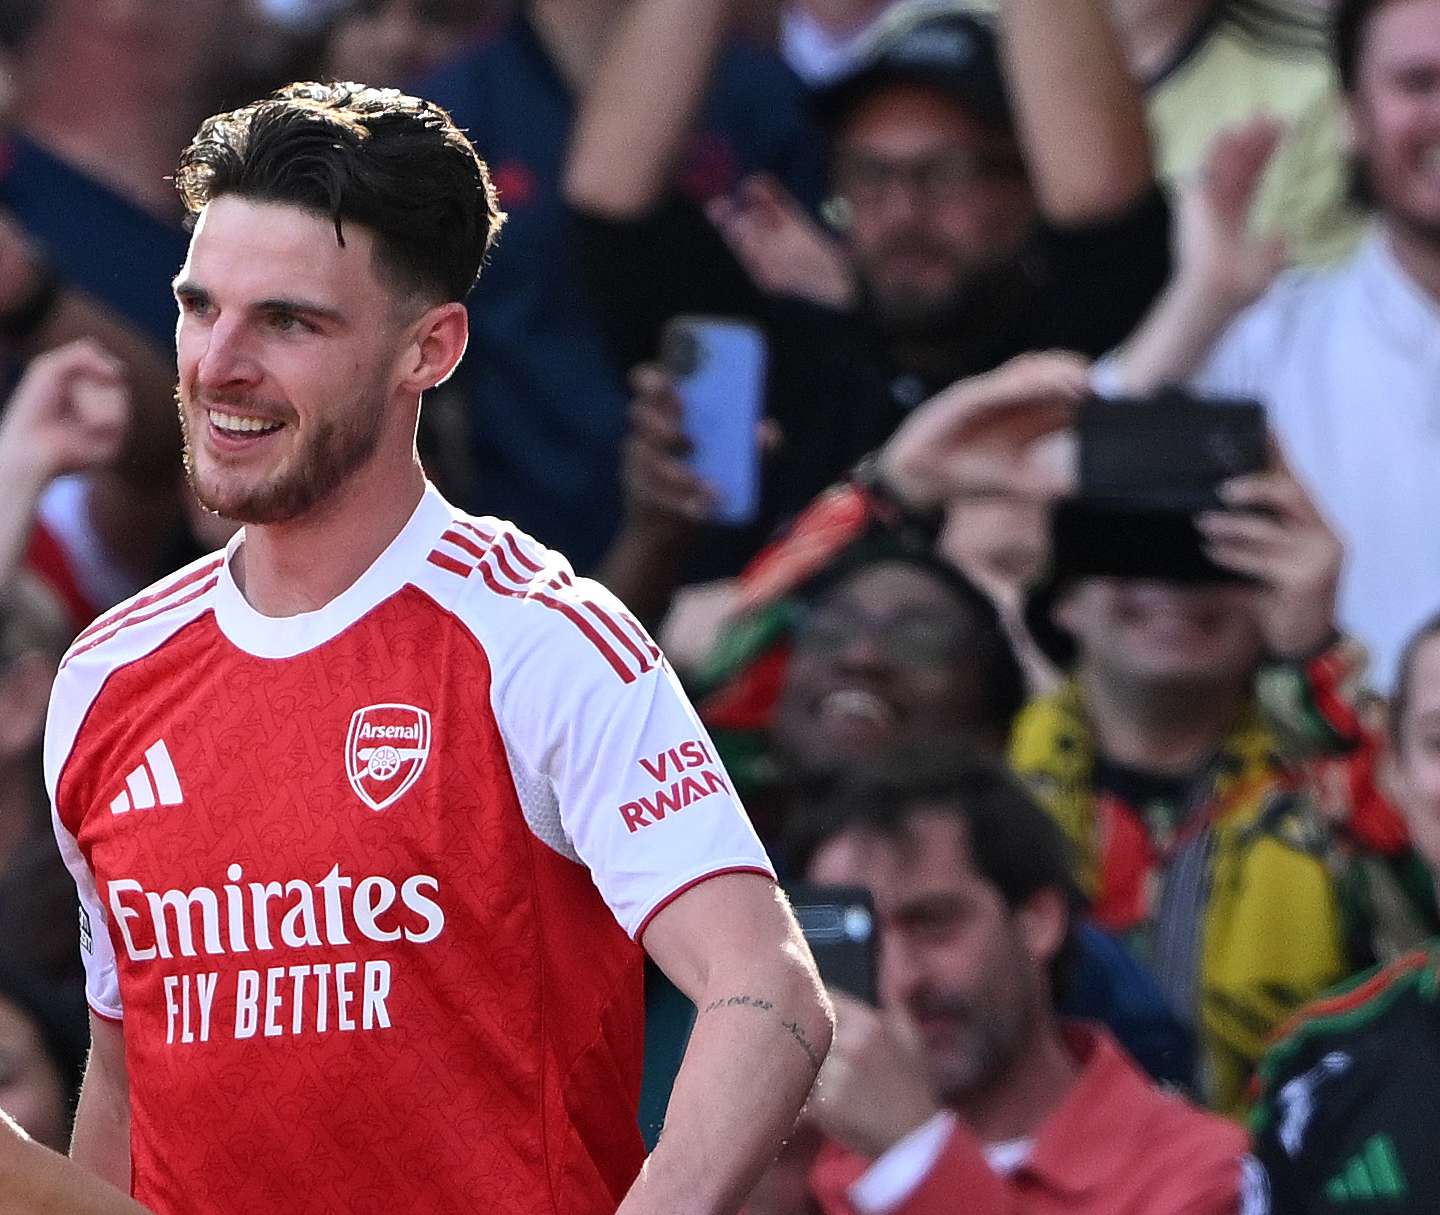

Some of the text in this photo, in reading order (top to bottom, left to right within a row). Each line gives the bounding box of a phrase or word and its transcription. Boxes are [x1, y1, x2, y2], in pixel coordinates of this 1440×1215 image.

[359, 722, 419, 740] Arsenal
[109, 864, 446, 963] Emirates
[163, 960, 393, 1045] FLY BETTER
